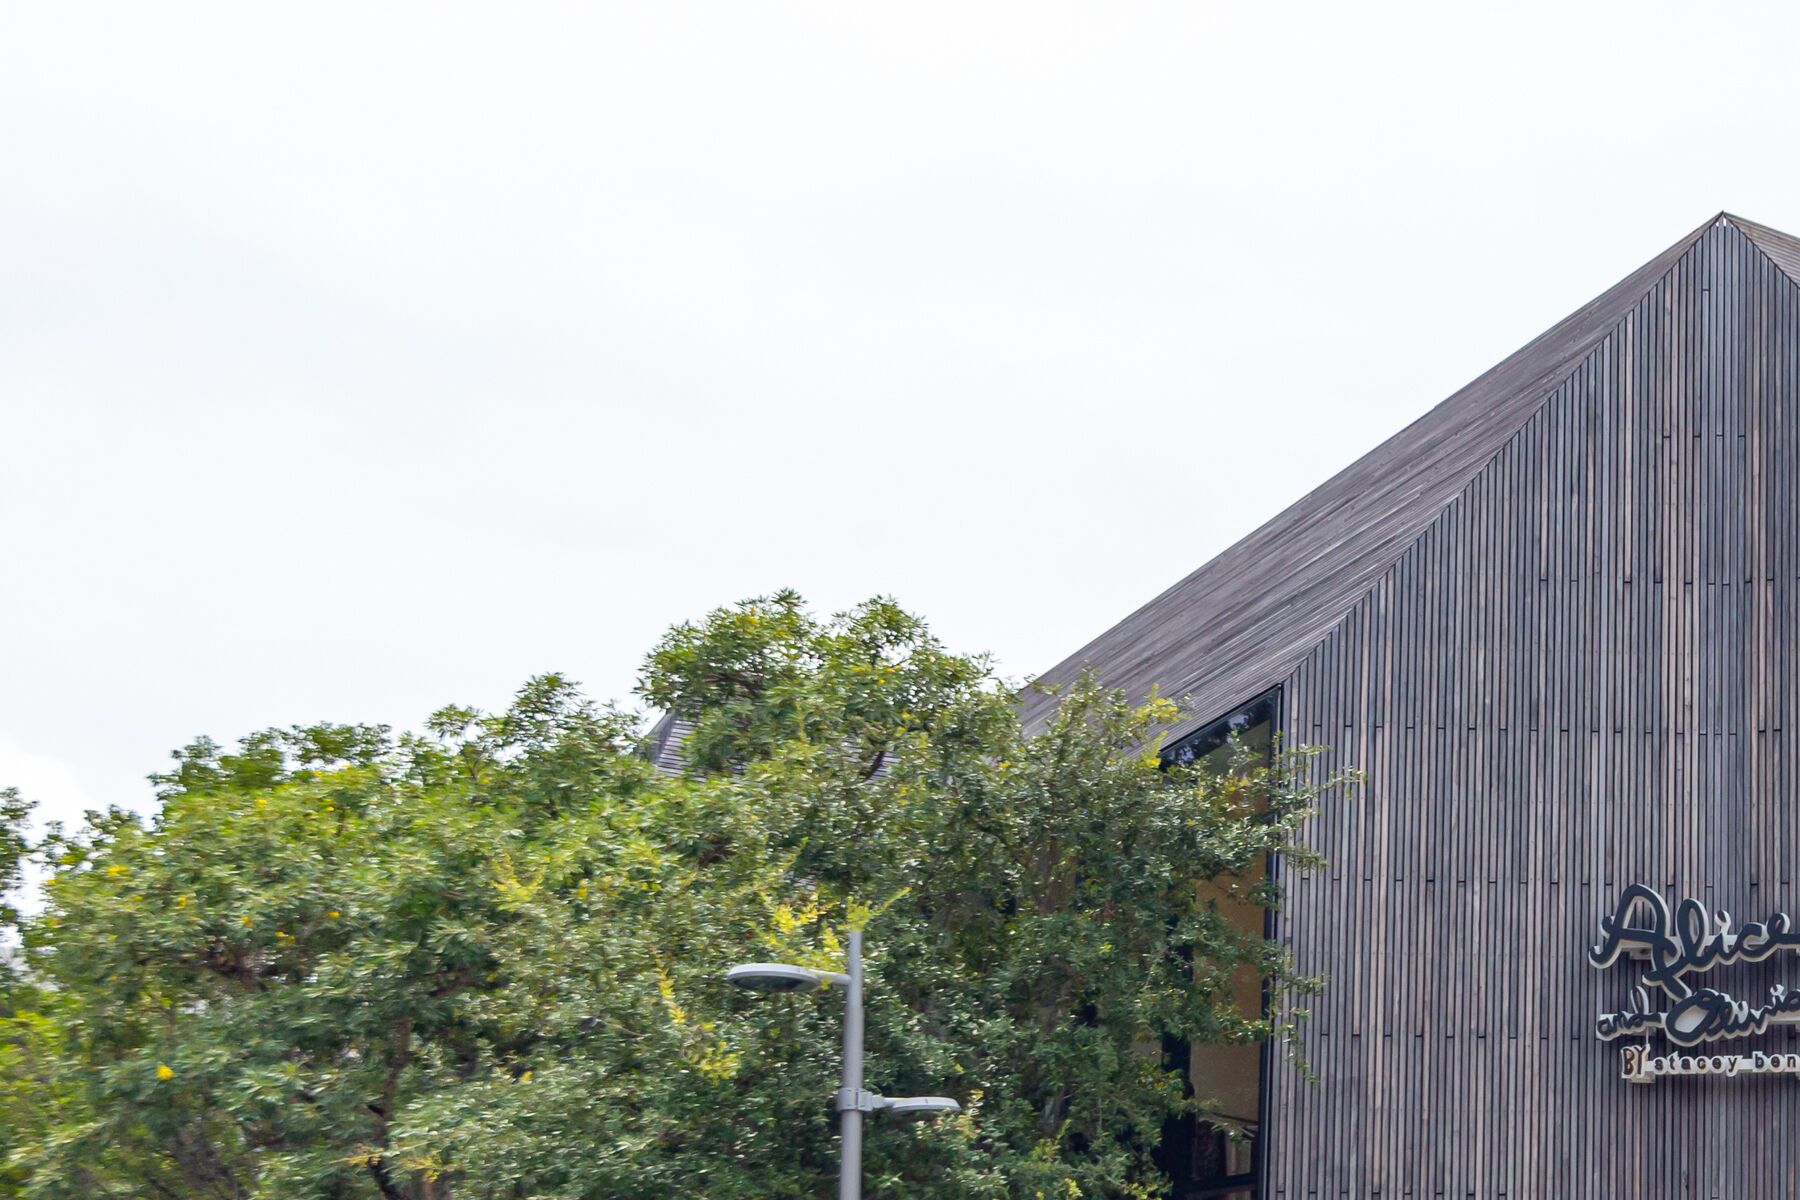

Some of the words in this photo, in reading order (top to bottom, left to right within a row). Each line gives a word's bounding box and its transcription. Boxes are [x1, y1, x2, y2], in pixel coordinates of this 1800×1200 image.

[1596, 986, 1662, 1041] and
[1621, 1045, 1650, 1078] BY
[1652, 1052, 1741, 1076] stacey
